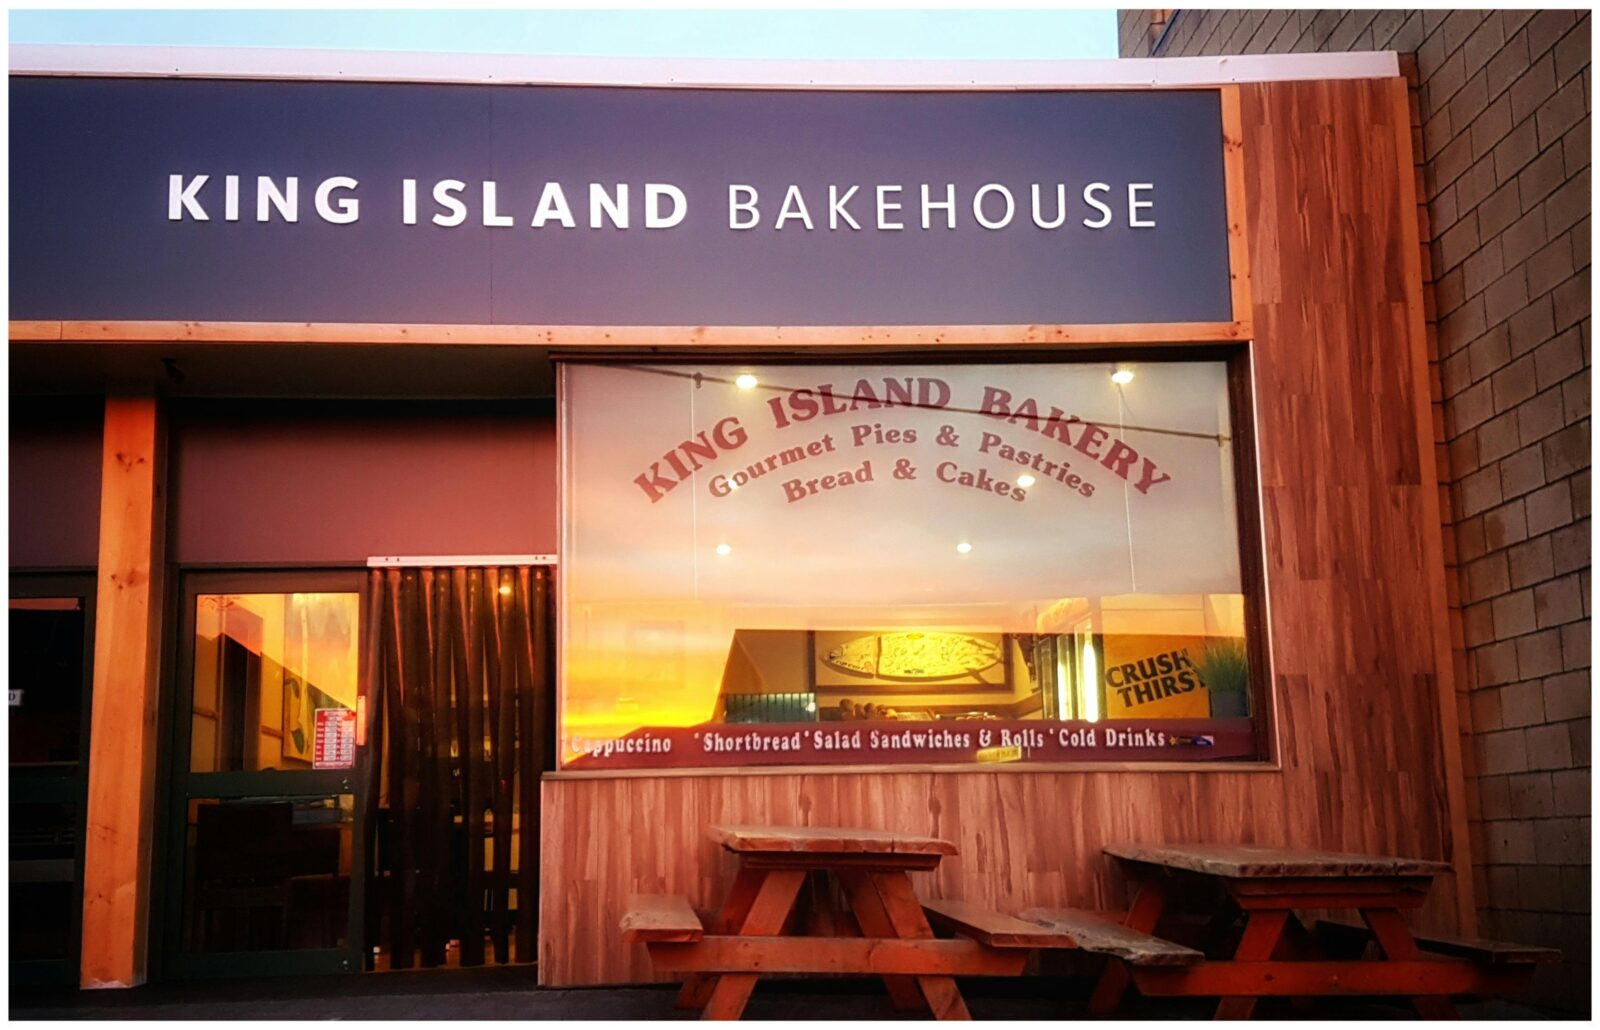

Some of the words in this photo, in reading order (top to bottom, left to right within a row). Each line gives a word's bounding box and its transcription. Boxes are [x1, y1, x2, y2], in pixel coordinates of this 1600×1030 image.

[168, 174, 360, 225] KING
[402, 178, 688, 229] ISLAND
[728, 182, 1157, 230] BAKEHOUSE
[633, 416, 748, 504] KING
[767, 377, 951, 430] ISLAND
[978, 386, 1171, 495] BAKERY
[708, 433, 836, 498] Gourmet
[851, 423, 918, 448] Pies
[935, 425, 960, 448] &
[978, 431, 1096, 499] Pastries
[781, 460, 875, 504] Bread
[892, 458, 918, 481] &
[936, 461, 1027, 502] Cakes
[1106, 648, 1193, 688] CRUSH
[1116, 671, 1204, 708] THIRS
[571, 733, 672, 757] Cappuccino
[870, 728, 970, 749] Sandwiches
[979, 728, 992, 748] &
[1000, 728, 1044, 748] Rolls
[1105, 727, 1166, 747] Drinks
